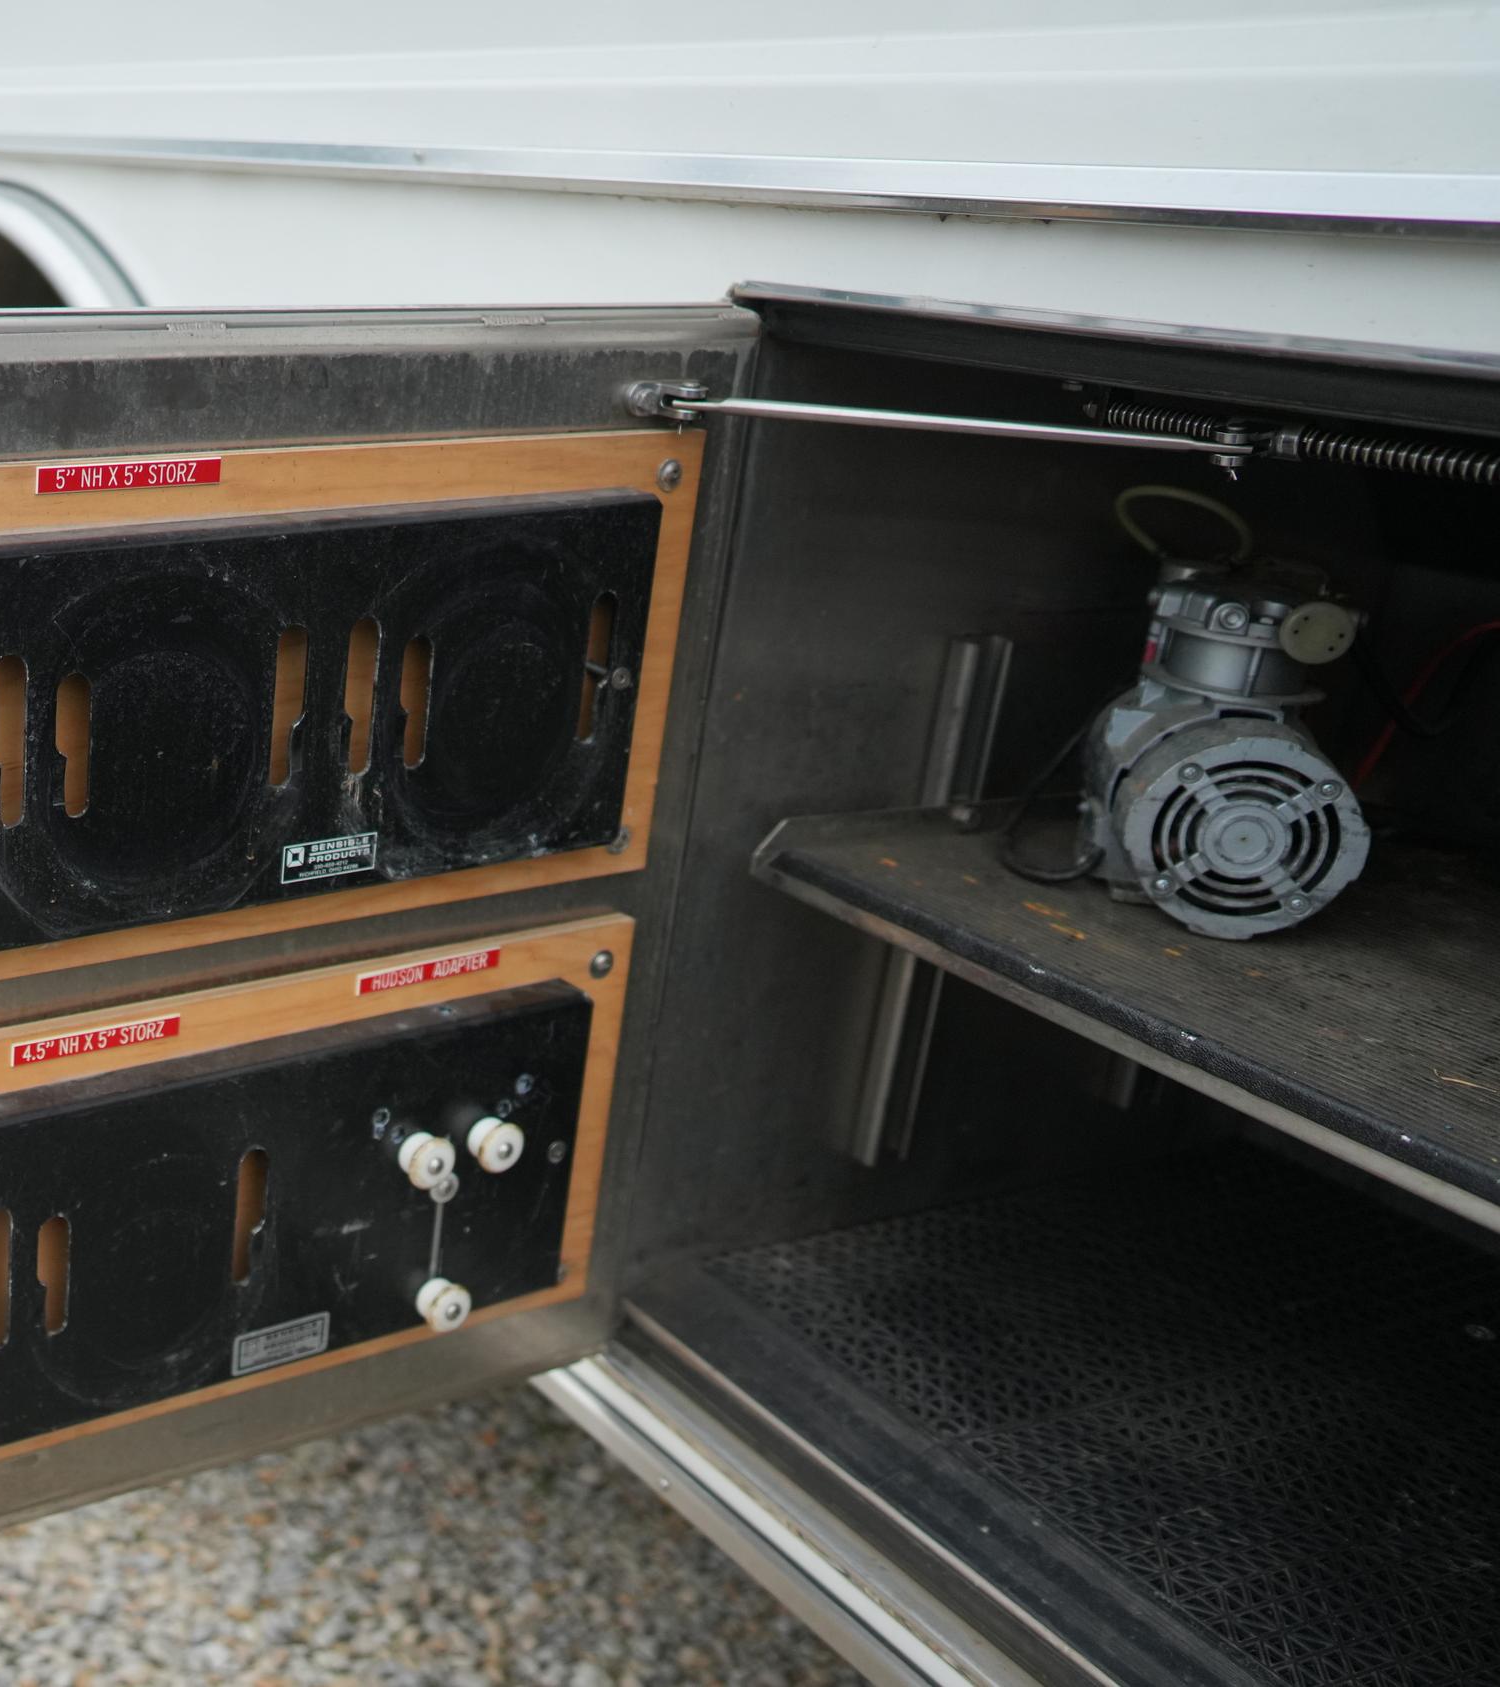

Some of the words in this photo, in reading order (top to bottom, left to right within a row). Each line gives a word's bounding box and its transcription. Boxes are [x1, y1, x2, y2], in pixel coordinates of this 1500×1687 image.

[81, 466, 102, 488] NH
[108, 465, 118, 487] X
[148, 462, 197, 484] STORZ
[308, 847, 371, 864] PRODUCTS
[311, 837, 369, 852] SENSIBLE
[371, 966, 424, 991] HUDSON
[432, 951, 489, 978] ADAPTER
[58, 1036, 79, 1056] NH
[83, 1033, 93, 1052] X
[119, 1020, 165, 1045] STORZ
